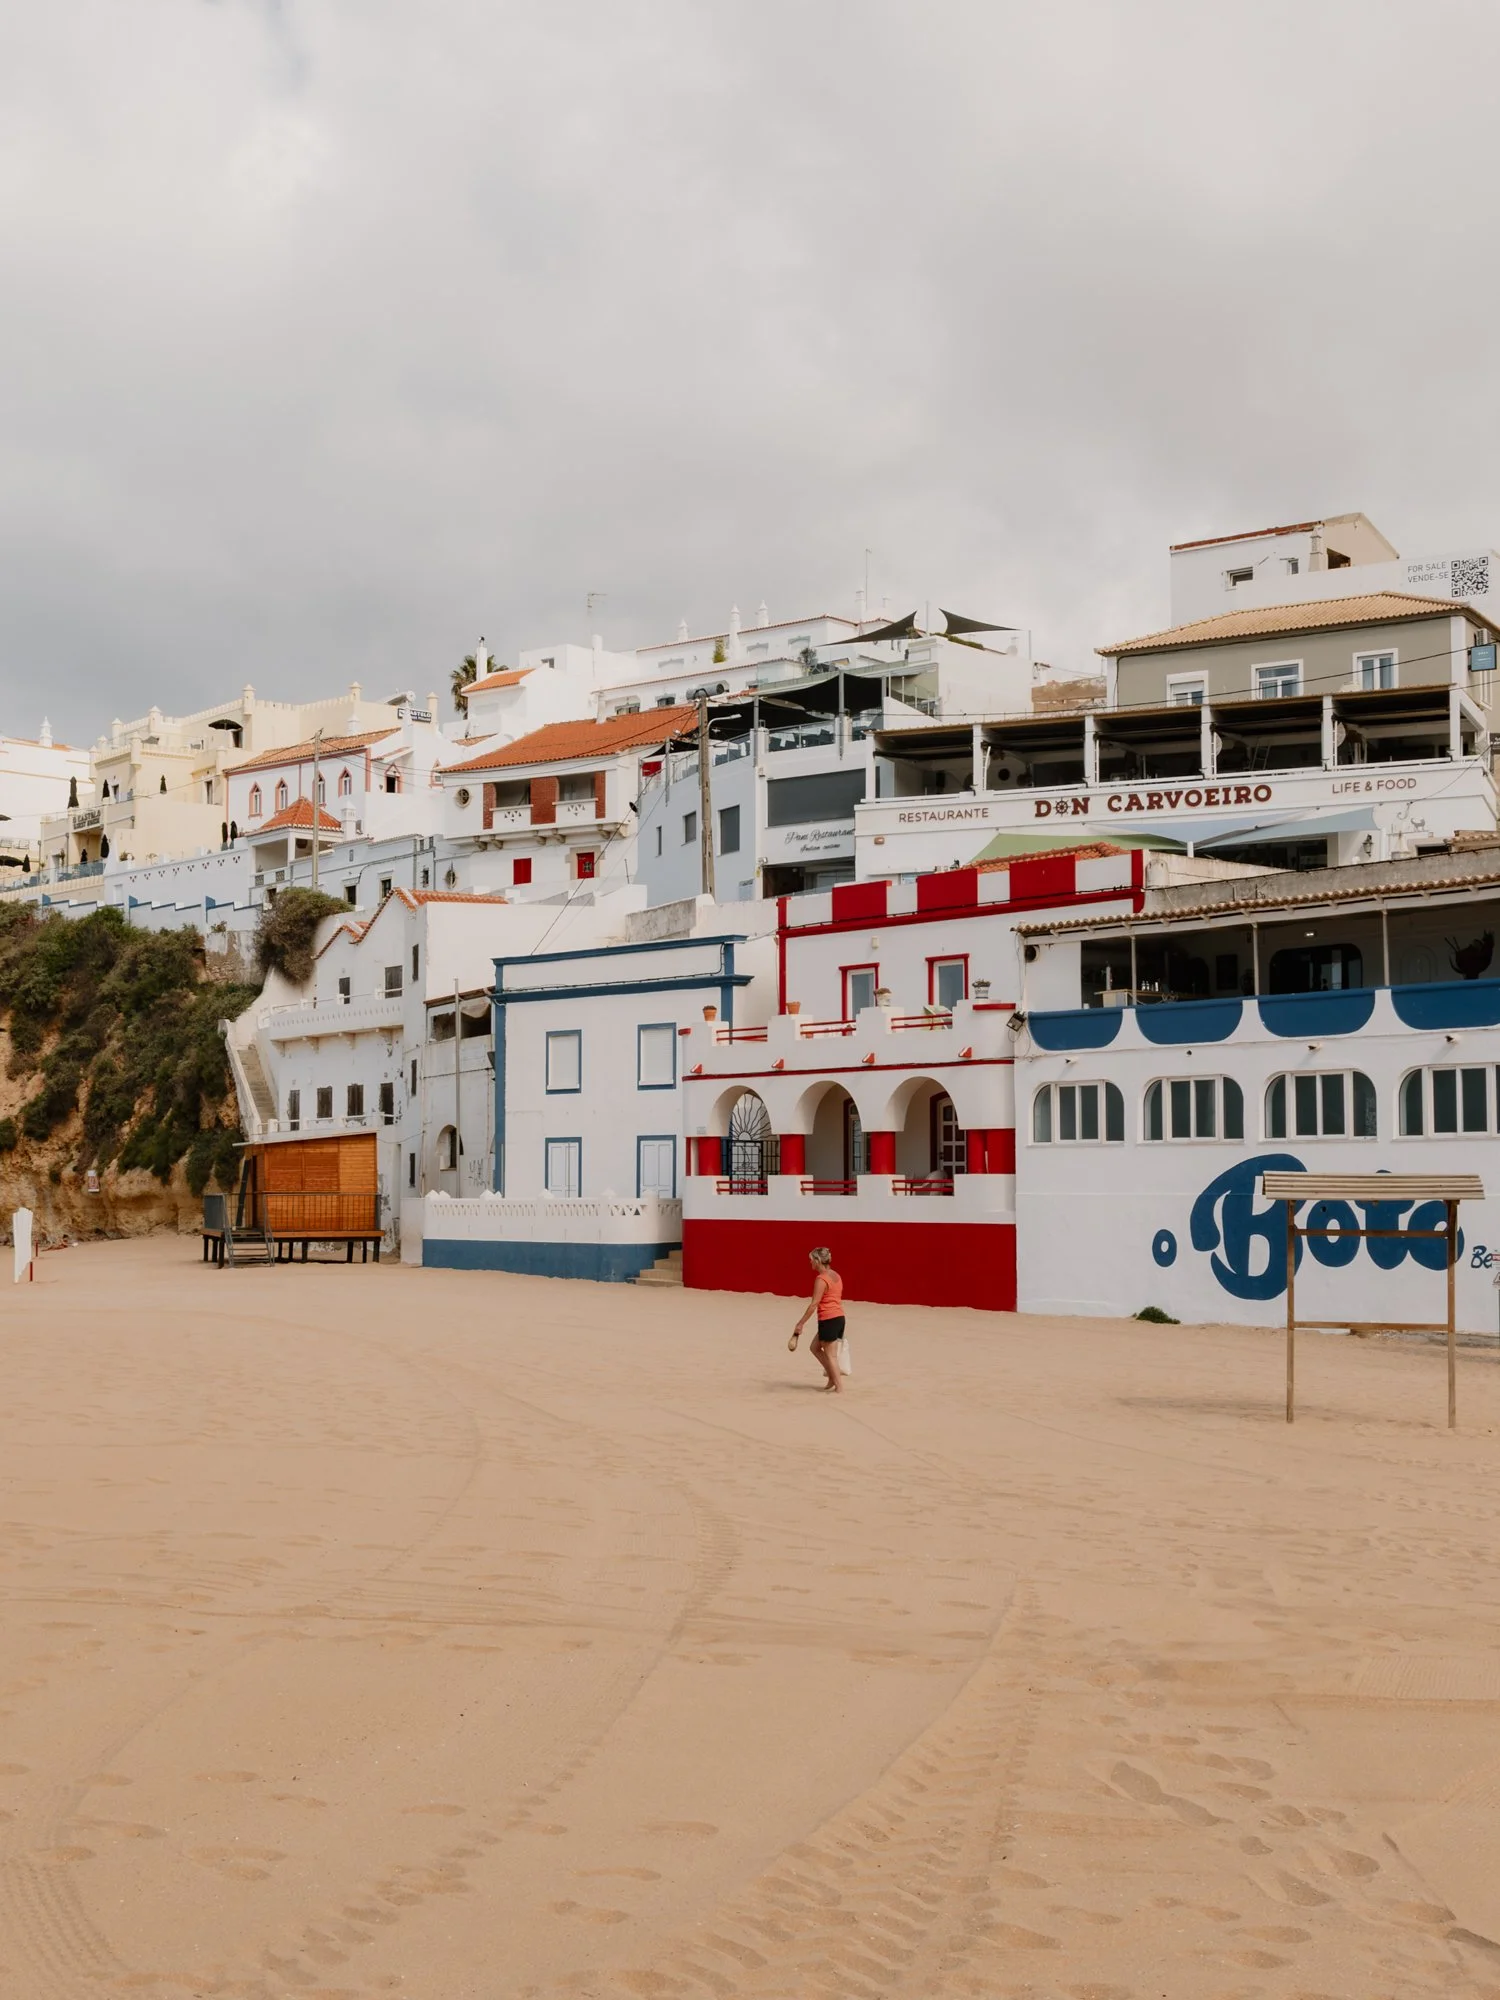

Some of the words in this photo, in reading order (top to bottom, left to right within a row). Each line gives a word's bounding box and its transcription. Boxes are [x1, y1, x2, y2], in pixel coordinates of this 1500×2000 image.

[1407, 564, 1424, 573] FOR
[1425, 561, 1447, 571] SALE
[1407, 571, 1449, 583] VENDE-SE
[1332, 781, 1361, 794] LIFE
[1364, 781, 1373, 792] &
[1377, 778, 1417, 791] FOOD
[899, 807, 989, 823] RESTAURANTE
[1107, 784, 1272, 813] CARVOEIRO
